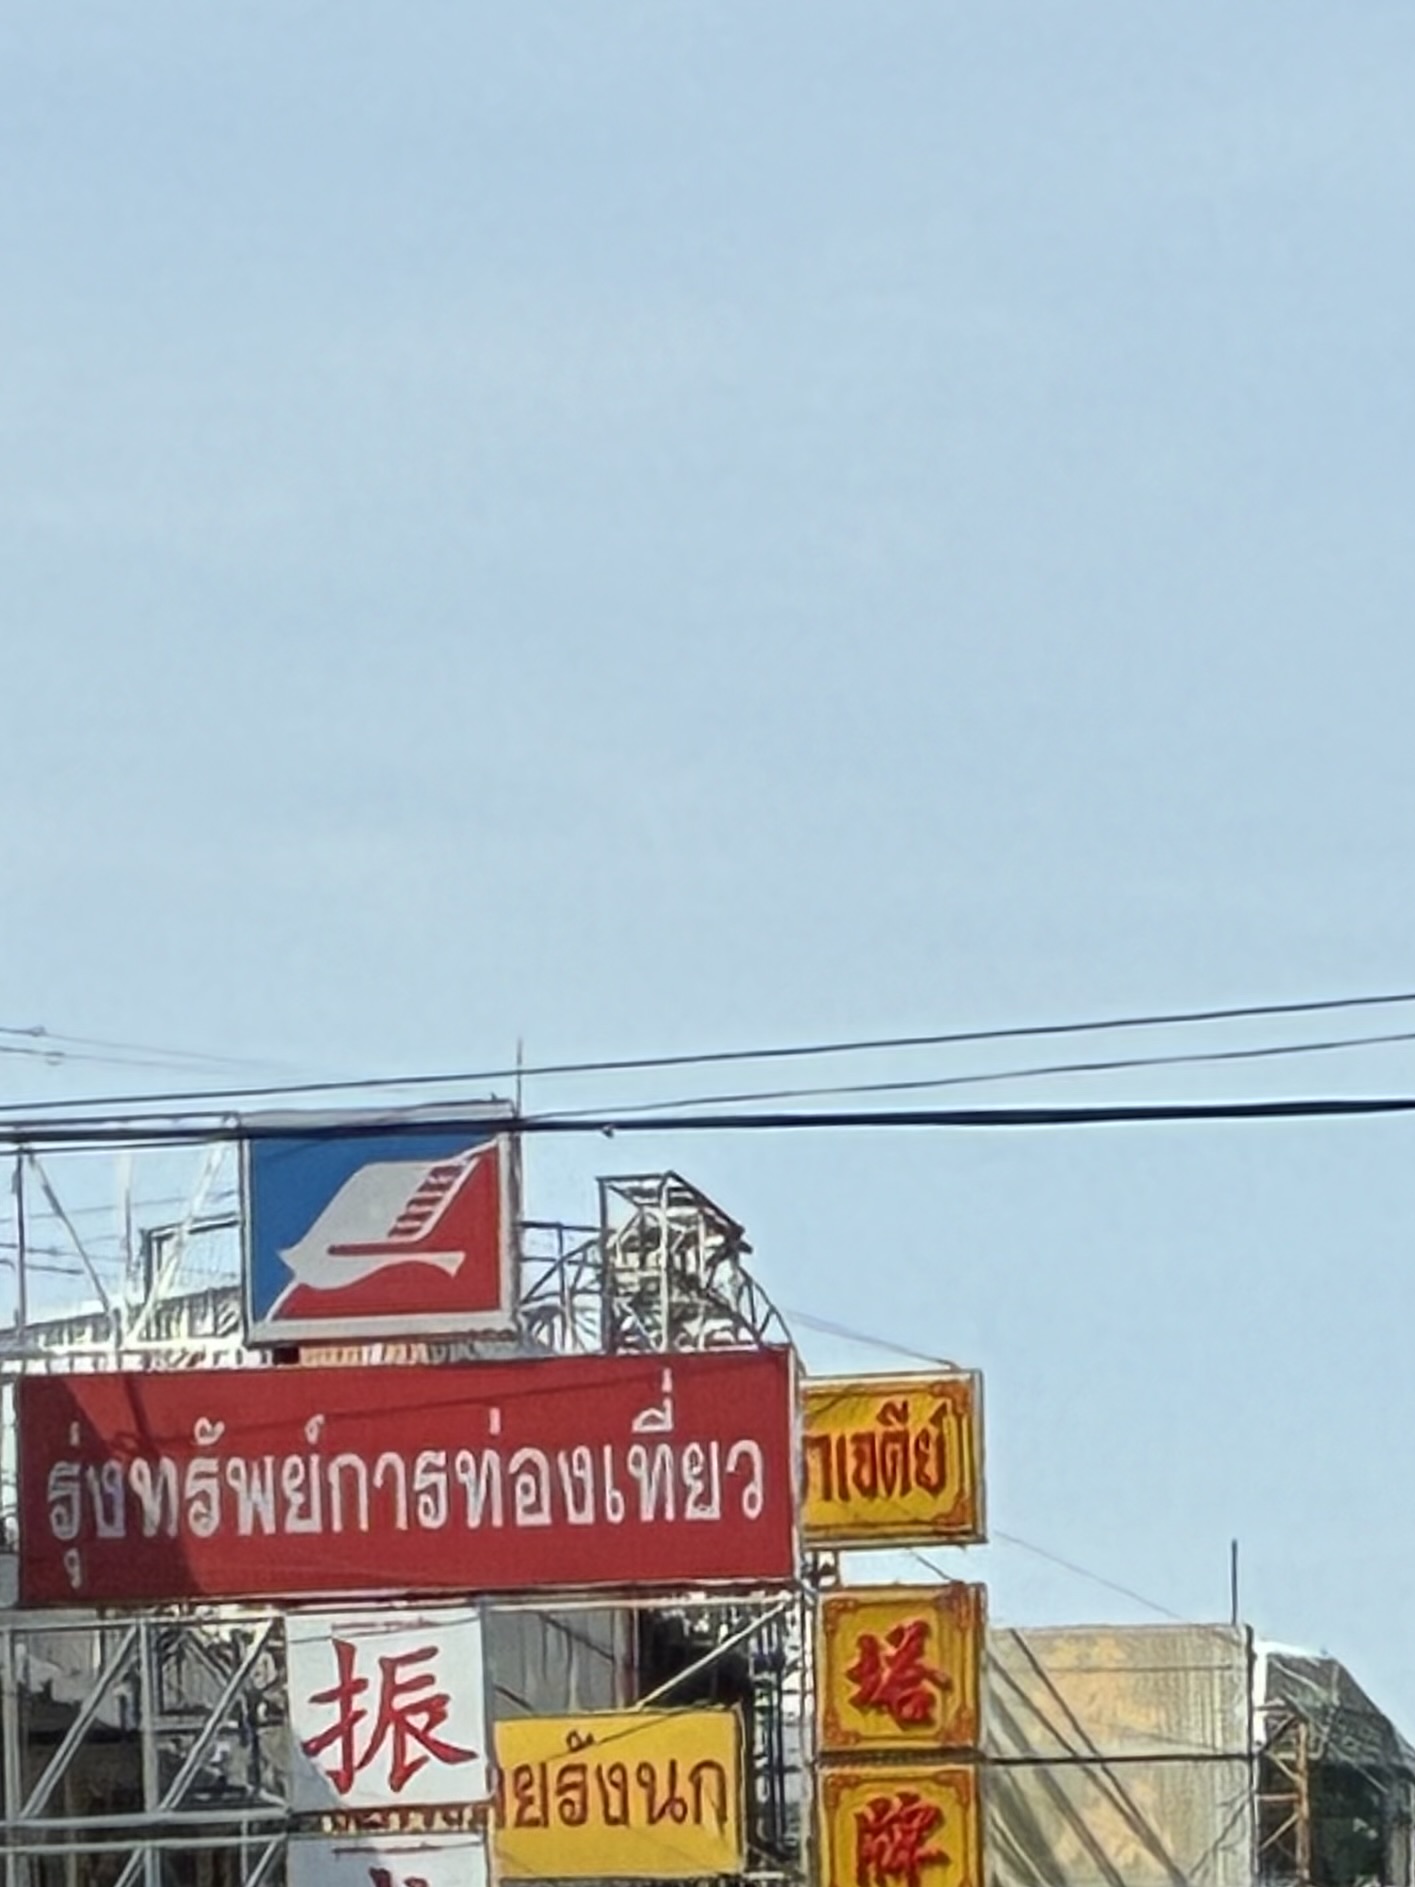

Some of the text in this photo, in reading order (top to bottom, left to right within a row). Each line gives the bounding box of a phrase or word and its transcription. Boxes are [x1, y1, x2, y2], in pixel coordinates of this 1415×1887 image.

[47, 1369, 766, 1589] รุ่งทรัพย์การท่องเที่ยว
